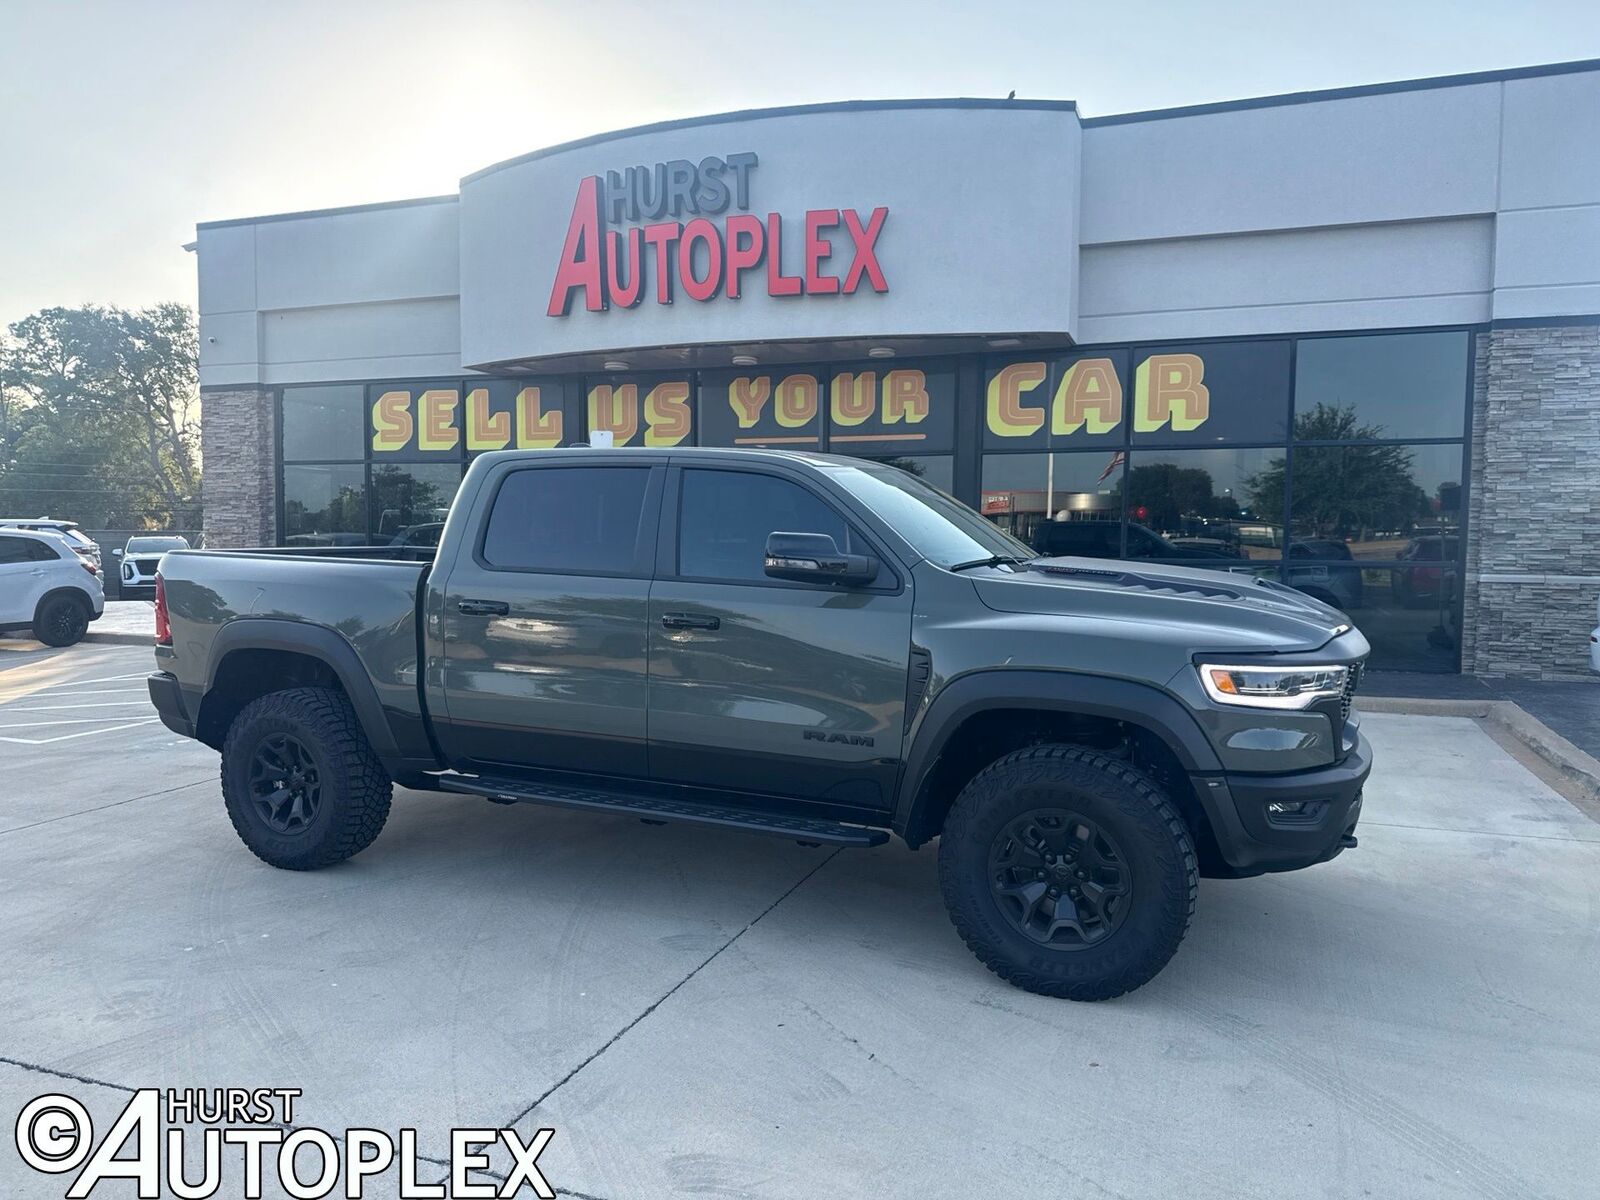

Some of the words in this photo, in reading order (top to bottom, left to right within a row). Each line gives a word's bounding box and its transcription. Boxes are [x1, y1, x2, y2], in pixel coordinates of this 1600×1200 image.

[606, 151, 758, 223] HURST
[546, 175, 889, 317] AUTOPLEX
[372, 388, 563, 451] SELL
[588, 382, 692, 447] US
[728, 369, 930, 428] YOUR
[987, 353, 1209, 437] CAR
[803, 730, 875, 748] RAM
